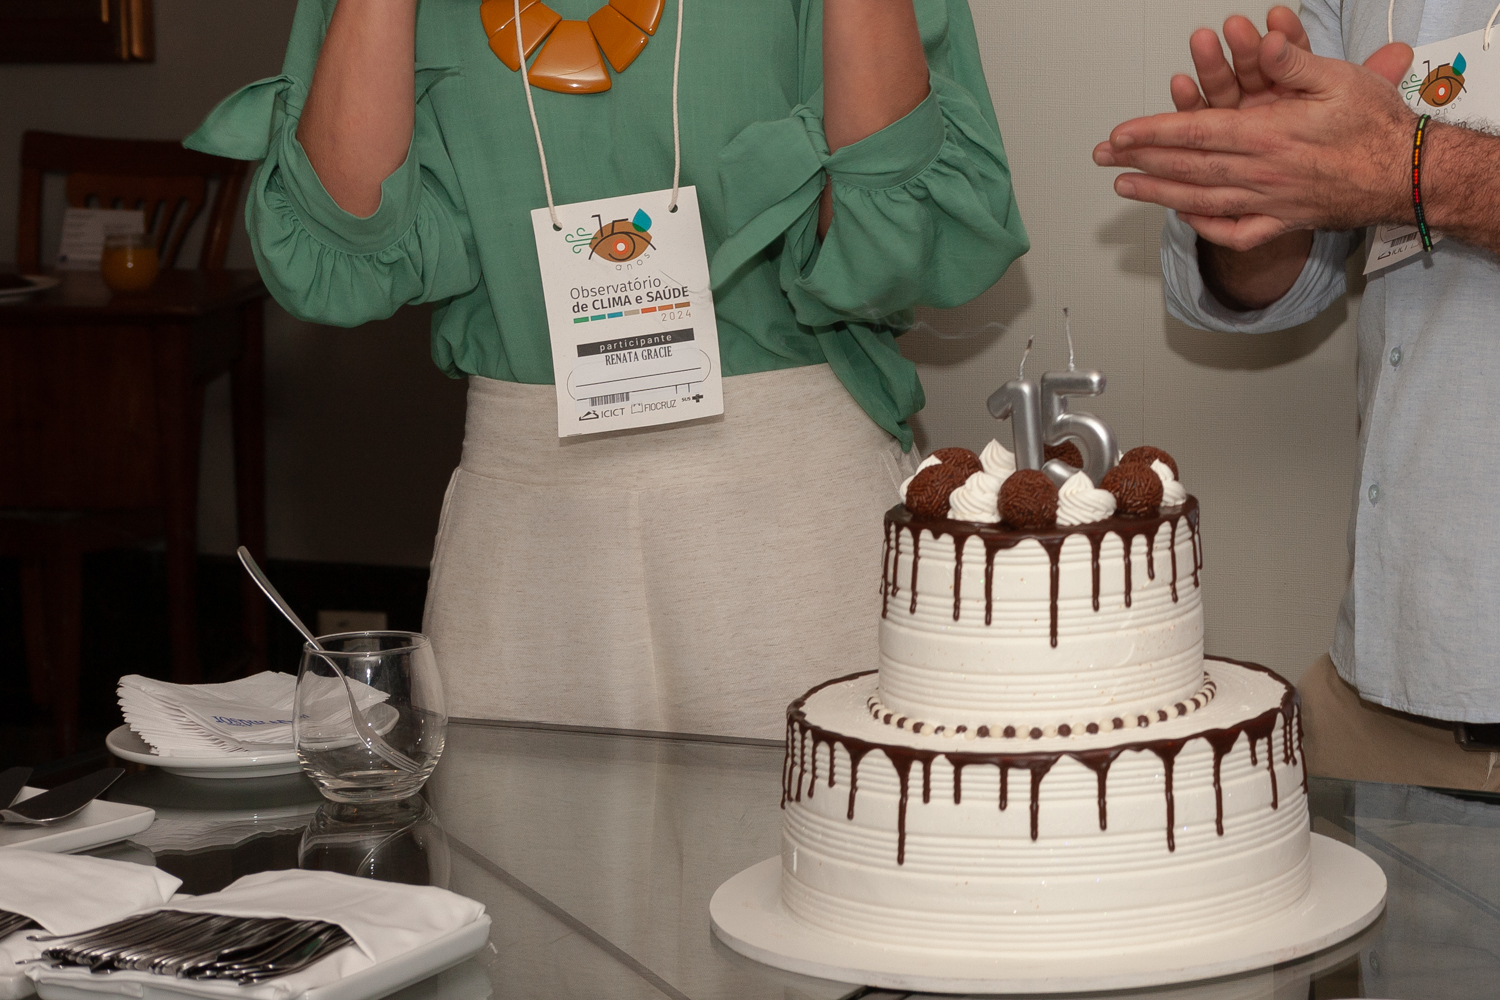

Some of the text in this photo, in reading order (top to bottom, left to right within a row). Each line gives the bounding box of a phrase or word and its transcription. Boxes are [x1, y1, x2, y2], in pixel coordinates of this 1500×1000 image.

[1435, 96, 1463, 116] anos
[615, 252, 651, 271] anos
[570, 275, 661, 300] Observatório
[572, 285, 690, 314] de CLIMA e SAÚDE
[661, 309, 691, 322] 2024
[599, 333, 672, 353] participante
[605, 345, 673, 366] RENATA GRACIE
[601, 407, 625, 419] ICICT
[644, 399, 677, 412] FIOCRUZ
[986, 369, 1119, 488] 15
